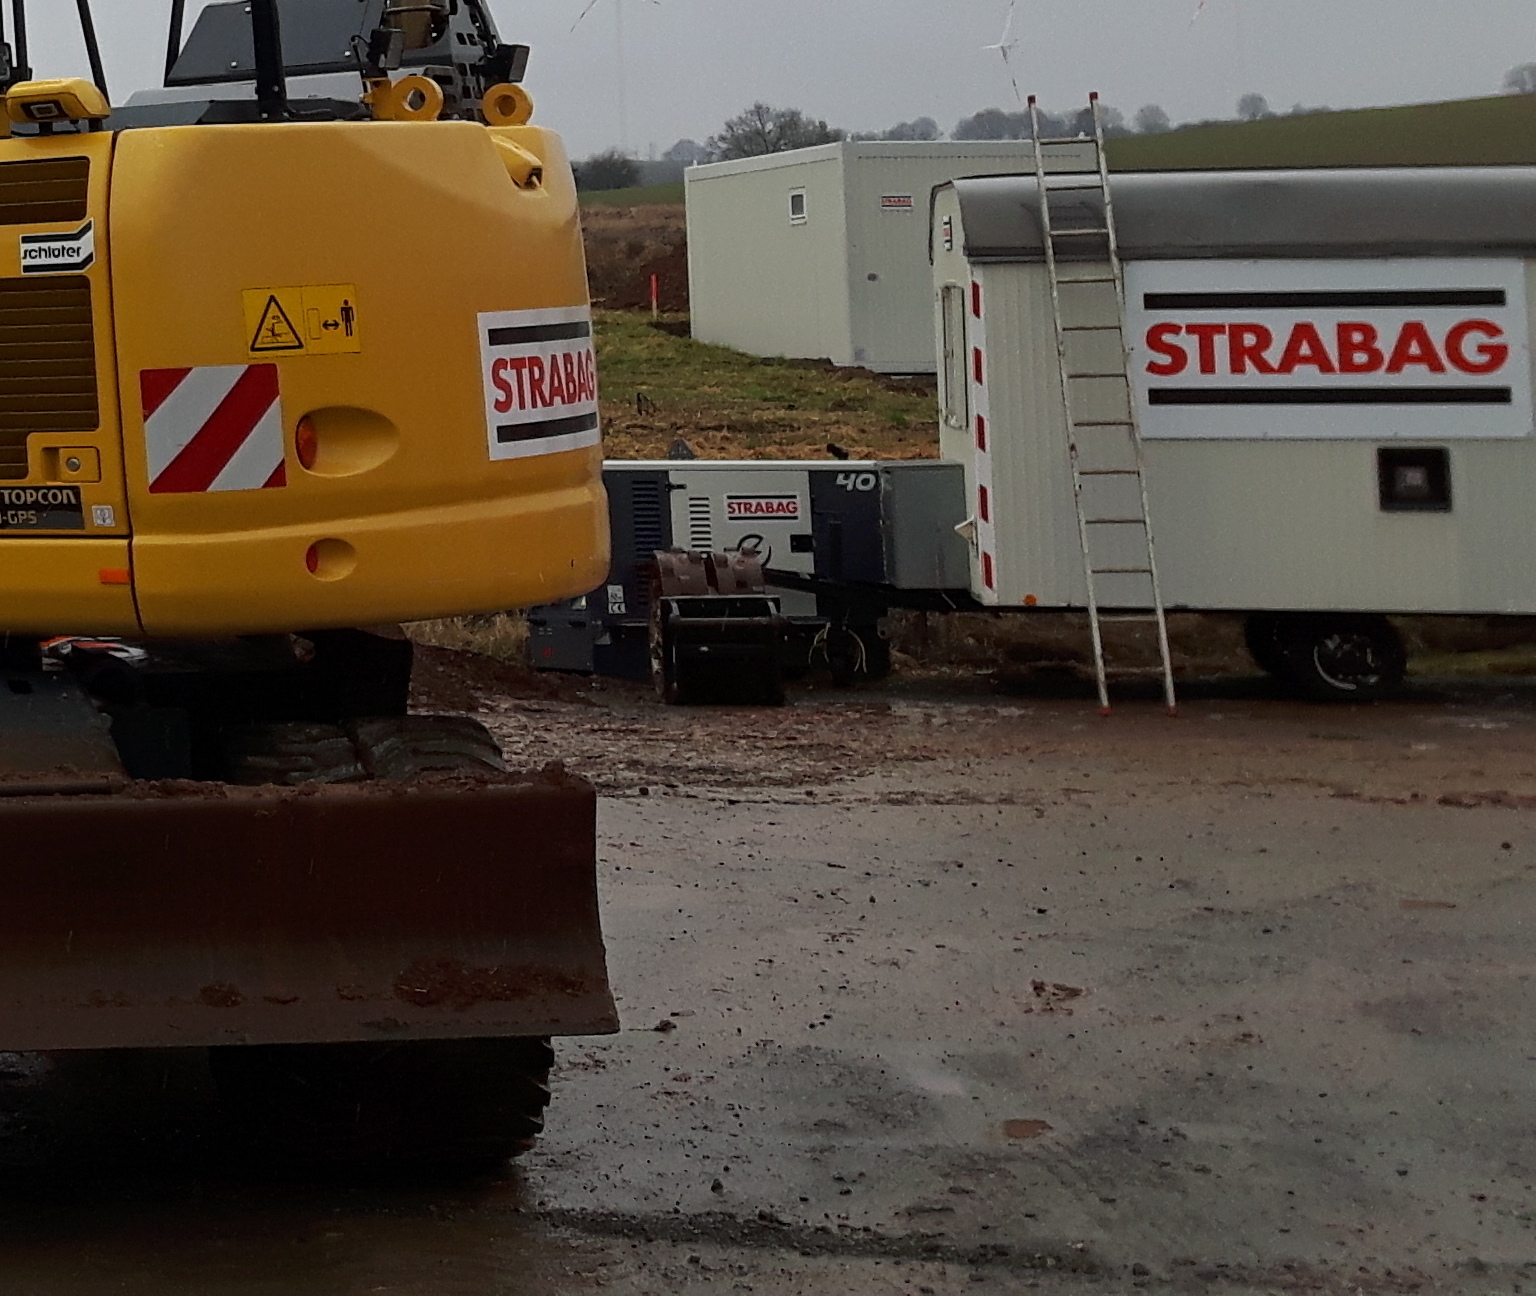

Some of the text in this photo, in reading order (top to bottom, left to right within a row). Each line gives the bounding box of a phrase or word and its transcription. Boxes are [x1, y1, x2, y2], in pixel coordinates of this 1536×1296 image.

[1145, 318, 1509, 376] STRABAG
[492, 348, 595, 414] STRABAG
[836, 473, 876, 491] 40
[0, 489, 77, 504] TOPCON
[727, 501, 798, 514] STRABAG
